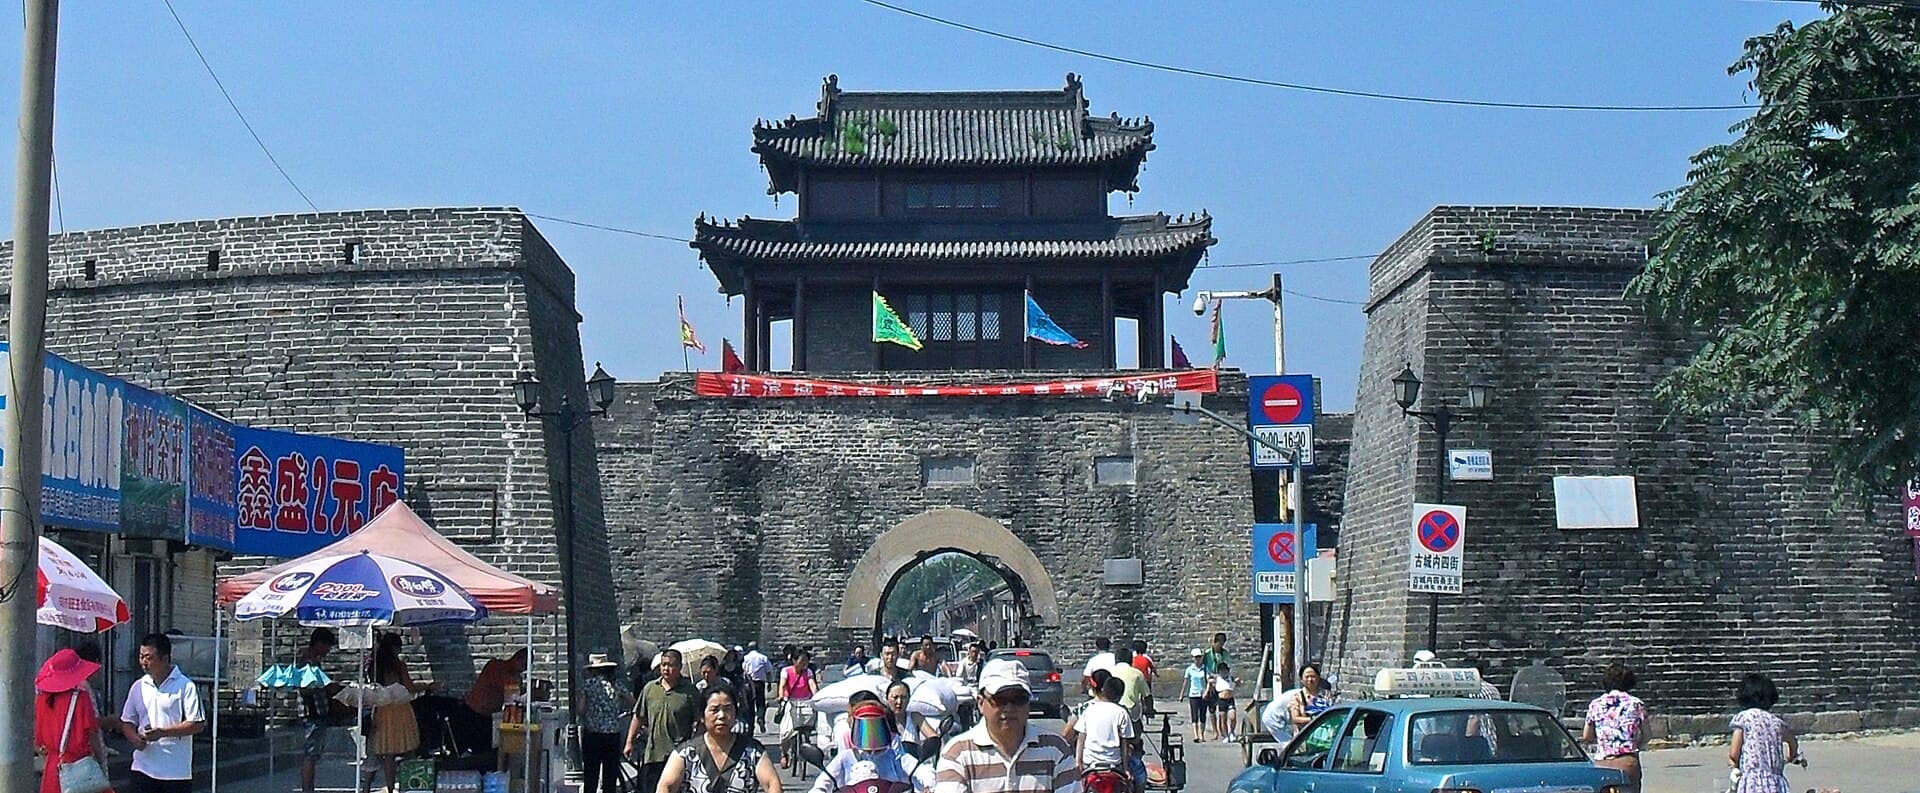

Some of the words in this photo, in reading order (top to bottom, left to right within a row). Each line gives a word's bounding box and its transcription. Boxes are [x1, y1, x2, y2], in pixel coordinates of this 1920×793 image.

[1414, 553, 1459, 571] 古城内四街
